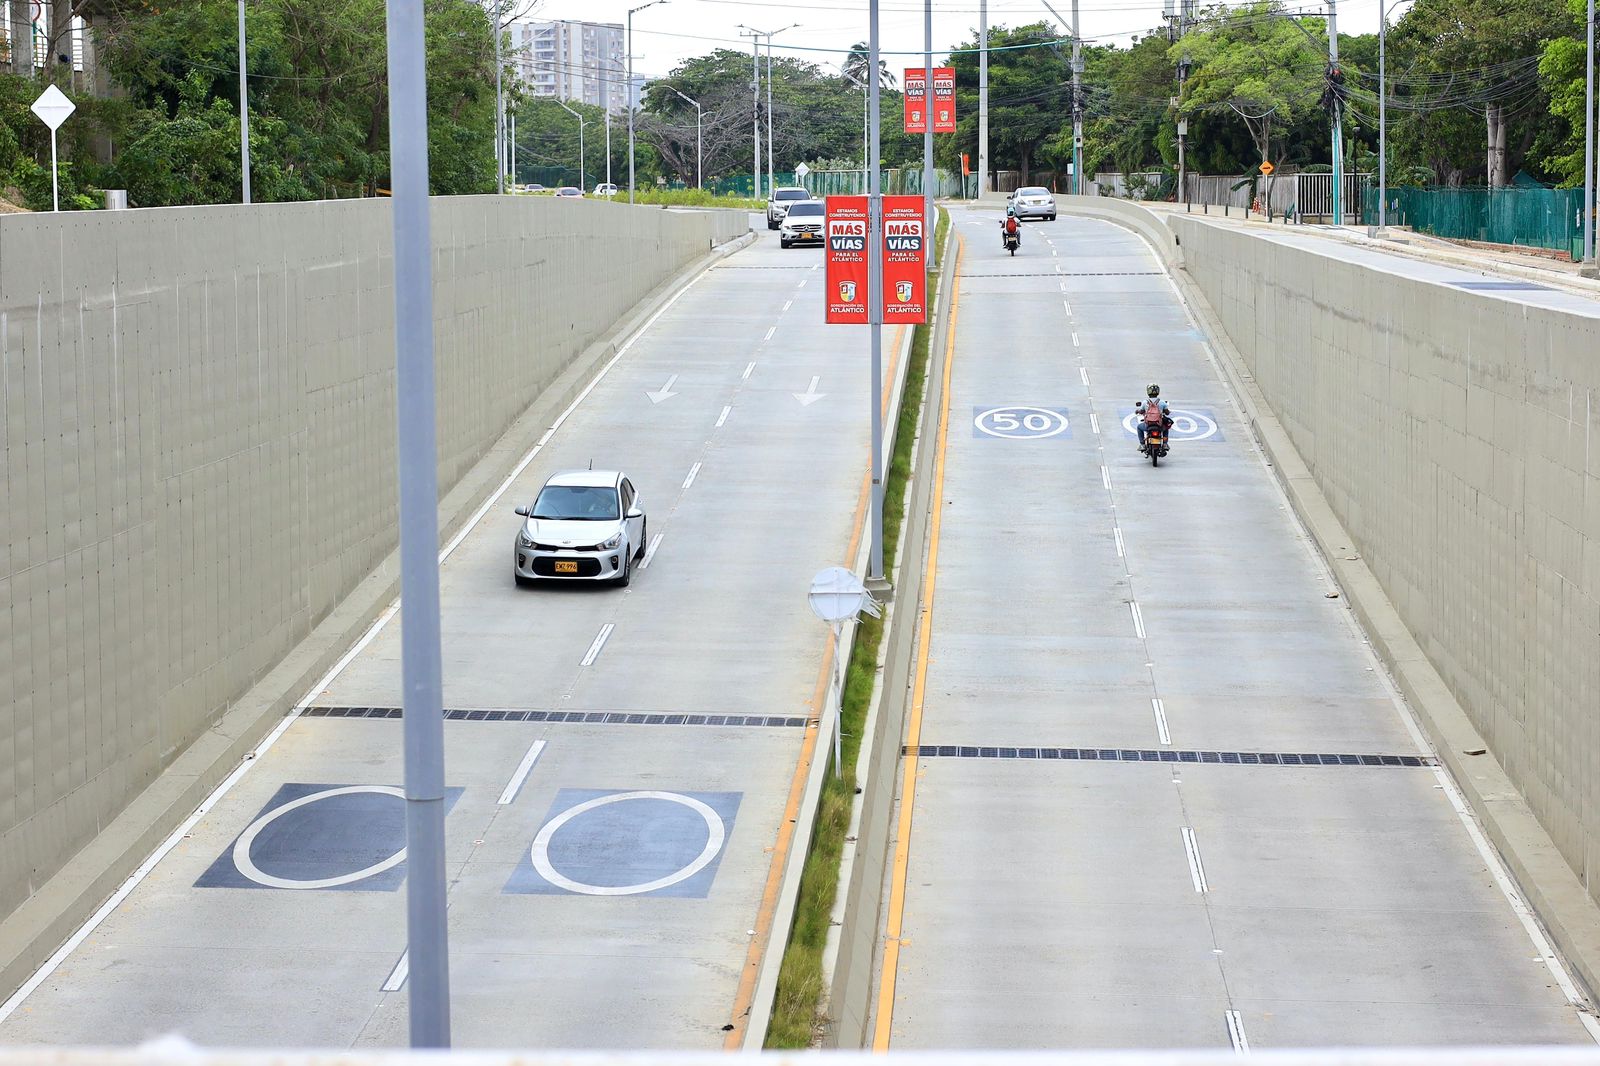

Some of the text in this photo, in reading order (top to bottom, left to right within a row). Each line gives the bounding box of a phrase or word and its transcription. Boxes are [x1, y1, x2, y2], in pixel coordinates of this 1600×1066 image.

[832, 222, 863, 235] MÁS
[888, 222, 919, 235] MÁS
[832, 238, 863, 249] VÍAS
[888, 238, 920, 249] VÍAS
[992, 414, 1052, 431] 50
